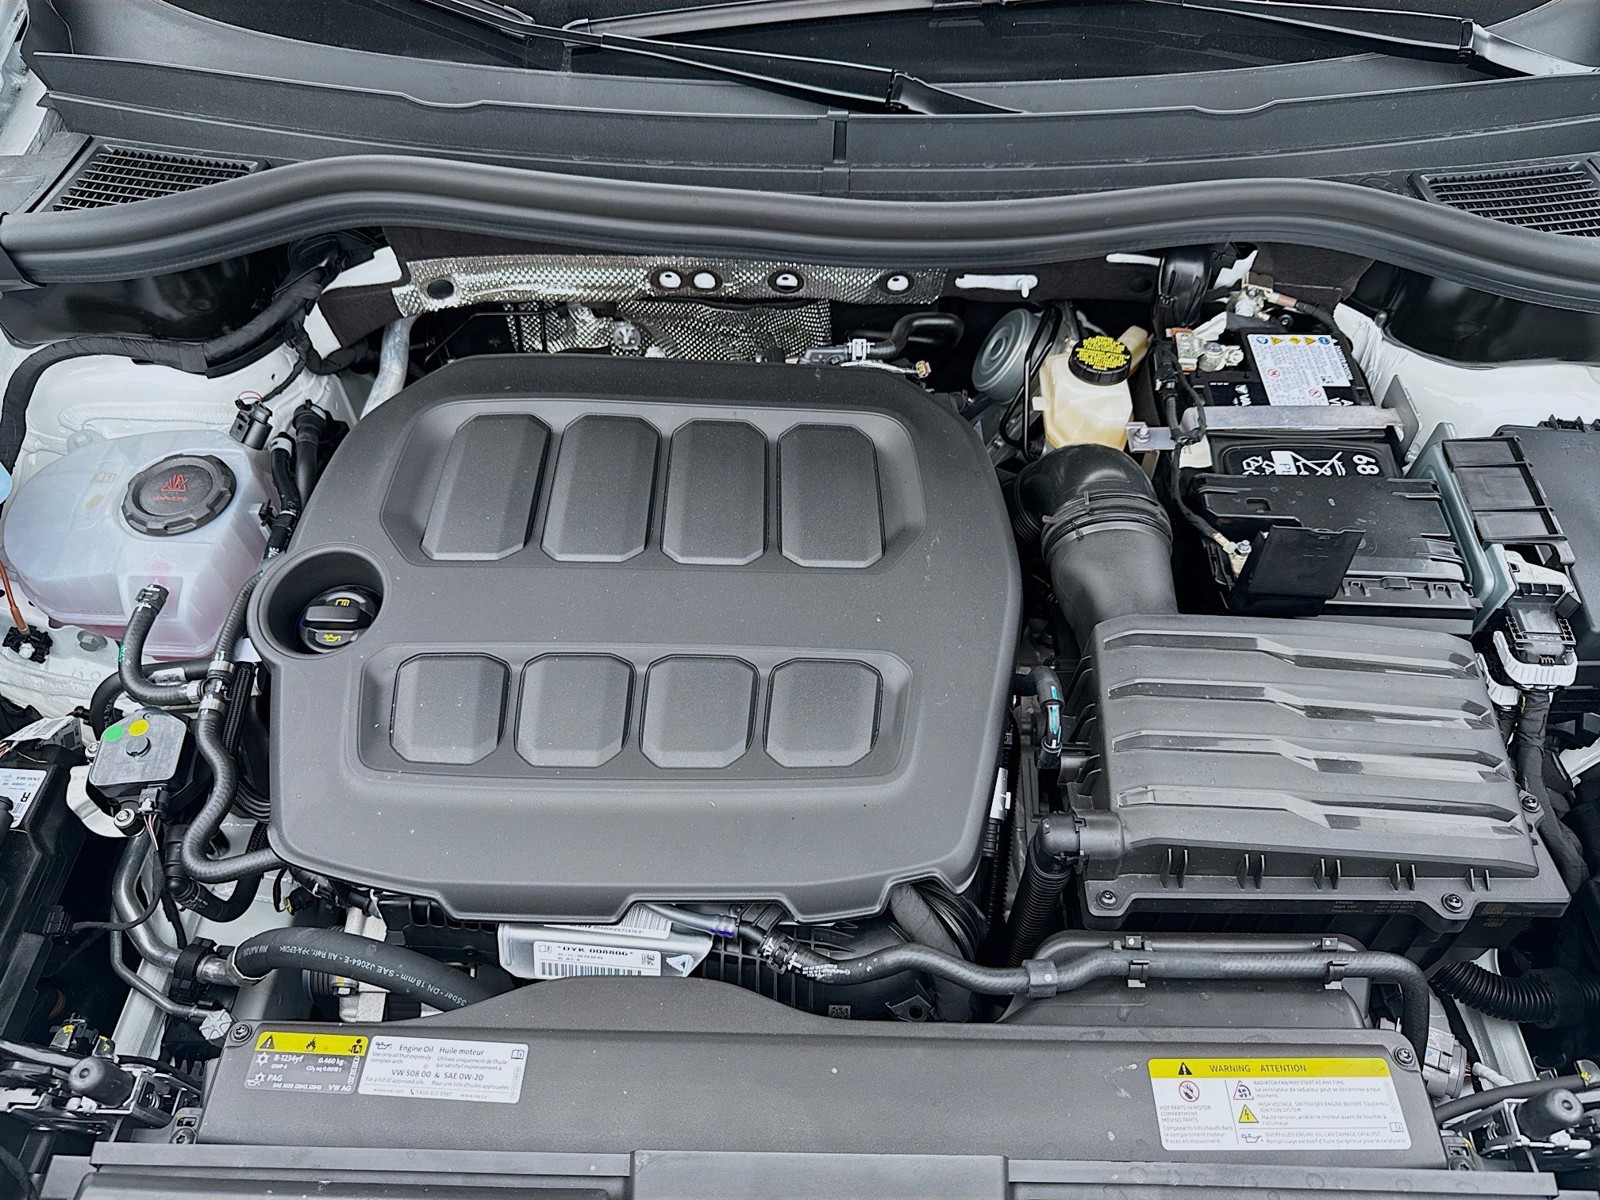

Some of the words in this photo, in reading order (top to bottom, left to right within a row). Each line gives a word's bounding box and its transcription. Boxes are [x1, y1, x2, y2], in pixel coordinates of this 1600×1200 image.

[1352, 454, 1380, 475] 68
[327, 952, 339, 961] All
[377, 965, 395, 977] SAE
[427, 983, 441, 995] DN
[444, 991, 467, 1006] 35bar
[399, 1044, 423, 1054] Engine
[423, 1045, 434, 1053] Oil
[439, 1046, 458, 1055] Huile
[458, 1048, 484, 1056] moteur
[273, 1054, 304, 1064] R-1234yf
[1209, 1064, 1251, 1073] WARNING
[1260, 1064, 1307, 1073] ATTENTION
[267, 1074, 283, 1082] PAG
[406, 1069, 420, 1077] 508
[421, 1070, 432, 1078] 00
[444, 1072, 458, 1080] SAE
